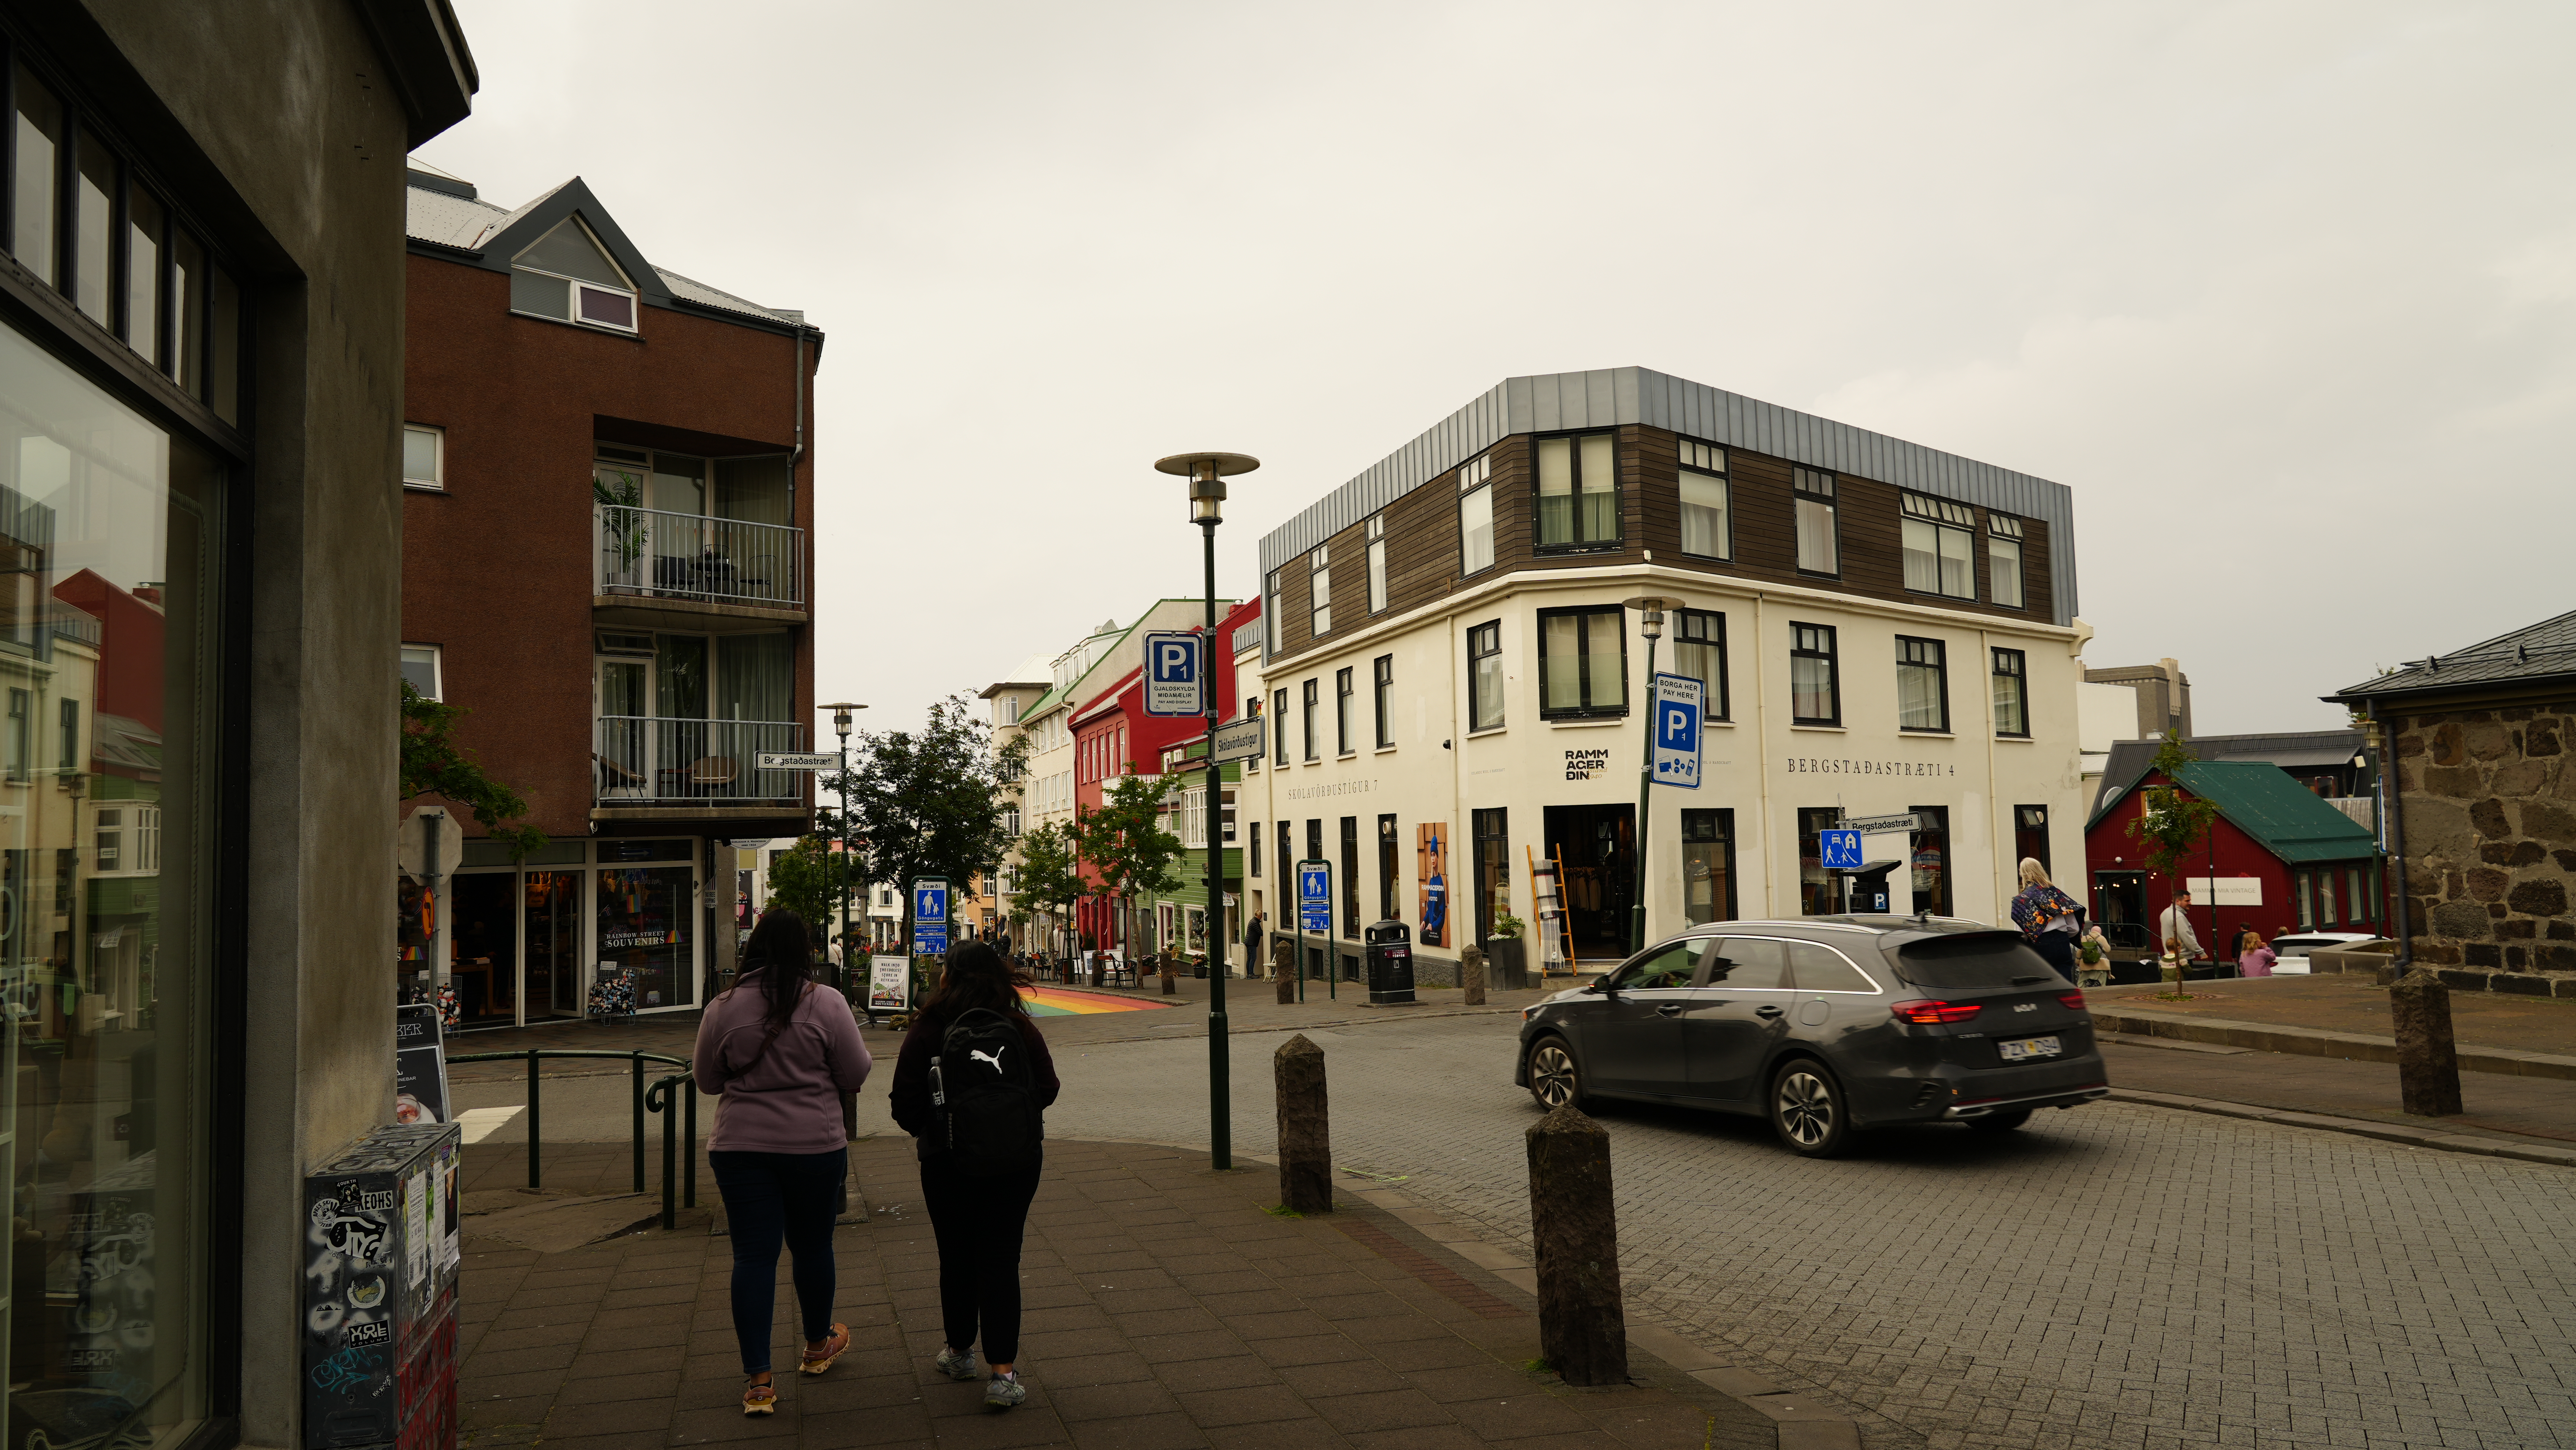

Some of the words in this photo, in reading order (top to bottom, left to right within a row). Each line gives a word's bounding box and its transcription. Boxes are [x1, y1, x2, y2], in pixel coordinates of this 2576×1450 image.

[1660, 680, 1682, 689] BORGA
[1677, 691, 1694, 699] HERE
[1219, 732, 1257, 752] Skólavörðustígur
[1565, 749, 1608, 760] RAMM
[765, 756, 833, 766] Begstaðastræti
[1566, 760, 1605, 770] AGER
[1788, 758, 1940, 776] BERGSTAÐASTRÆTI
[1949, 765, 1954, 776] 4
[1566, 771, 1590, 780] ÐIN
[1289, 779, 1369, 800] SKÓLAVÖRÐUSTÍGUR
[1374, 780, 1378, 791] 7
[605, 937, 665, 947] SOUVENIRS
[313, 1204, 322, 1217] APRES
[352, 1337, 388, 1346] VOLUME
